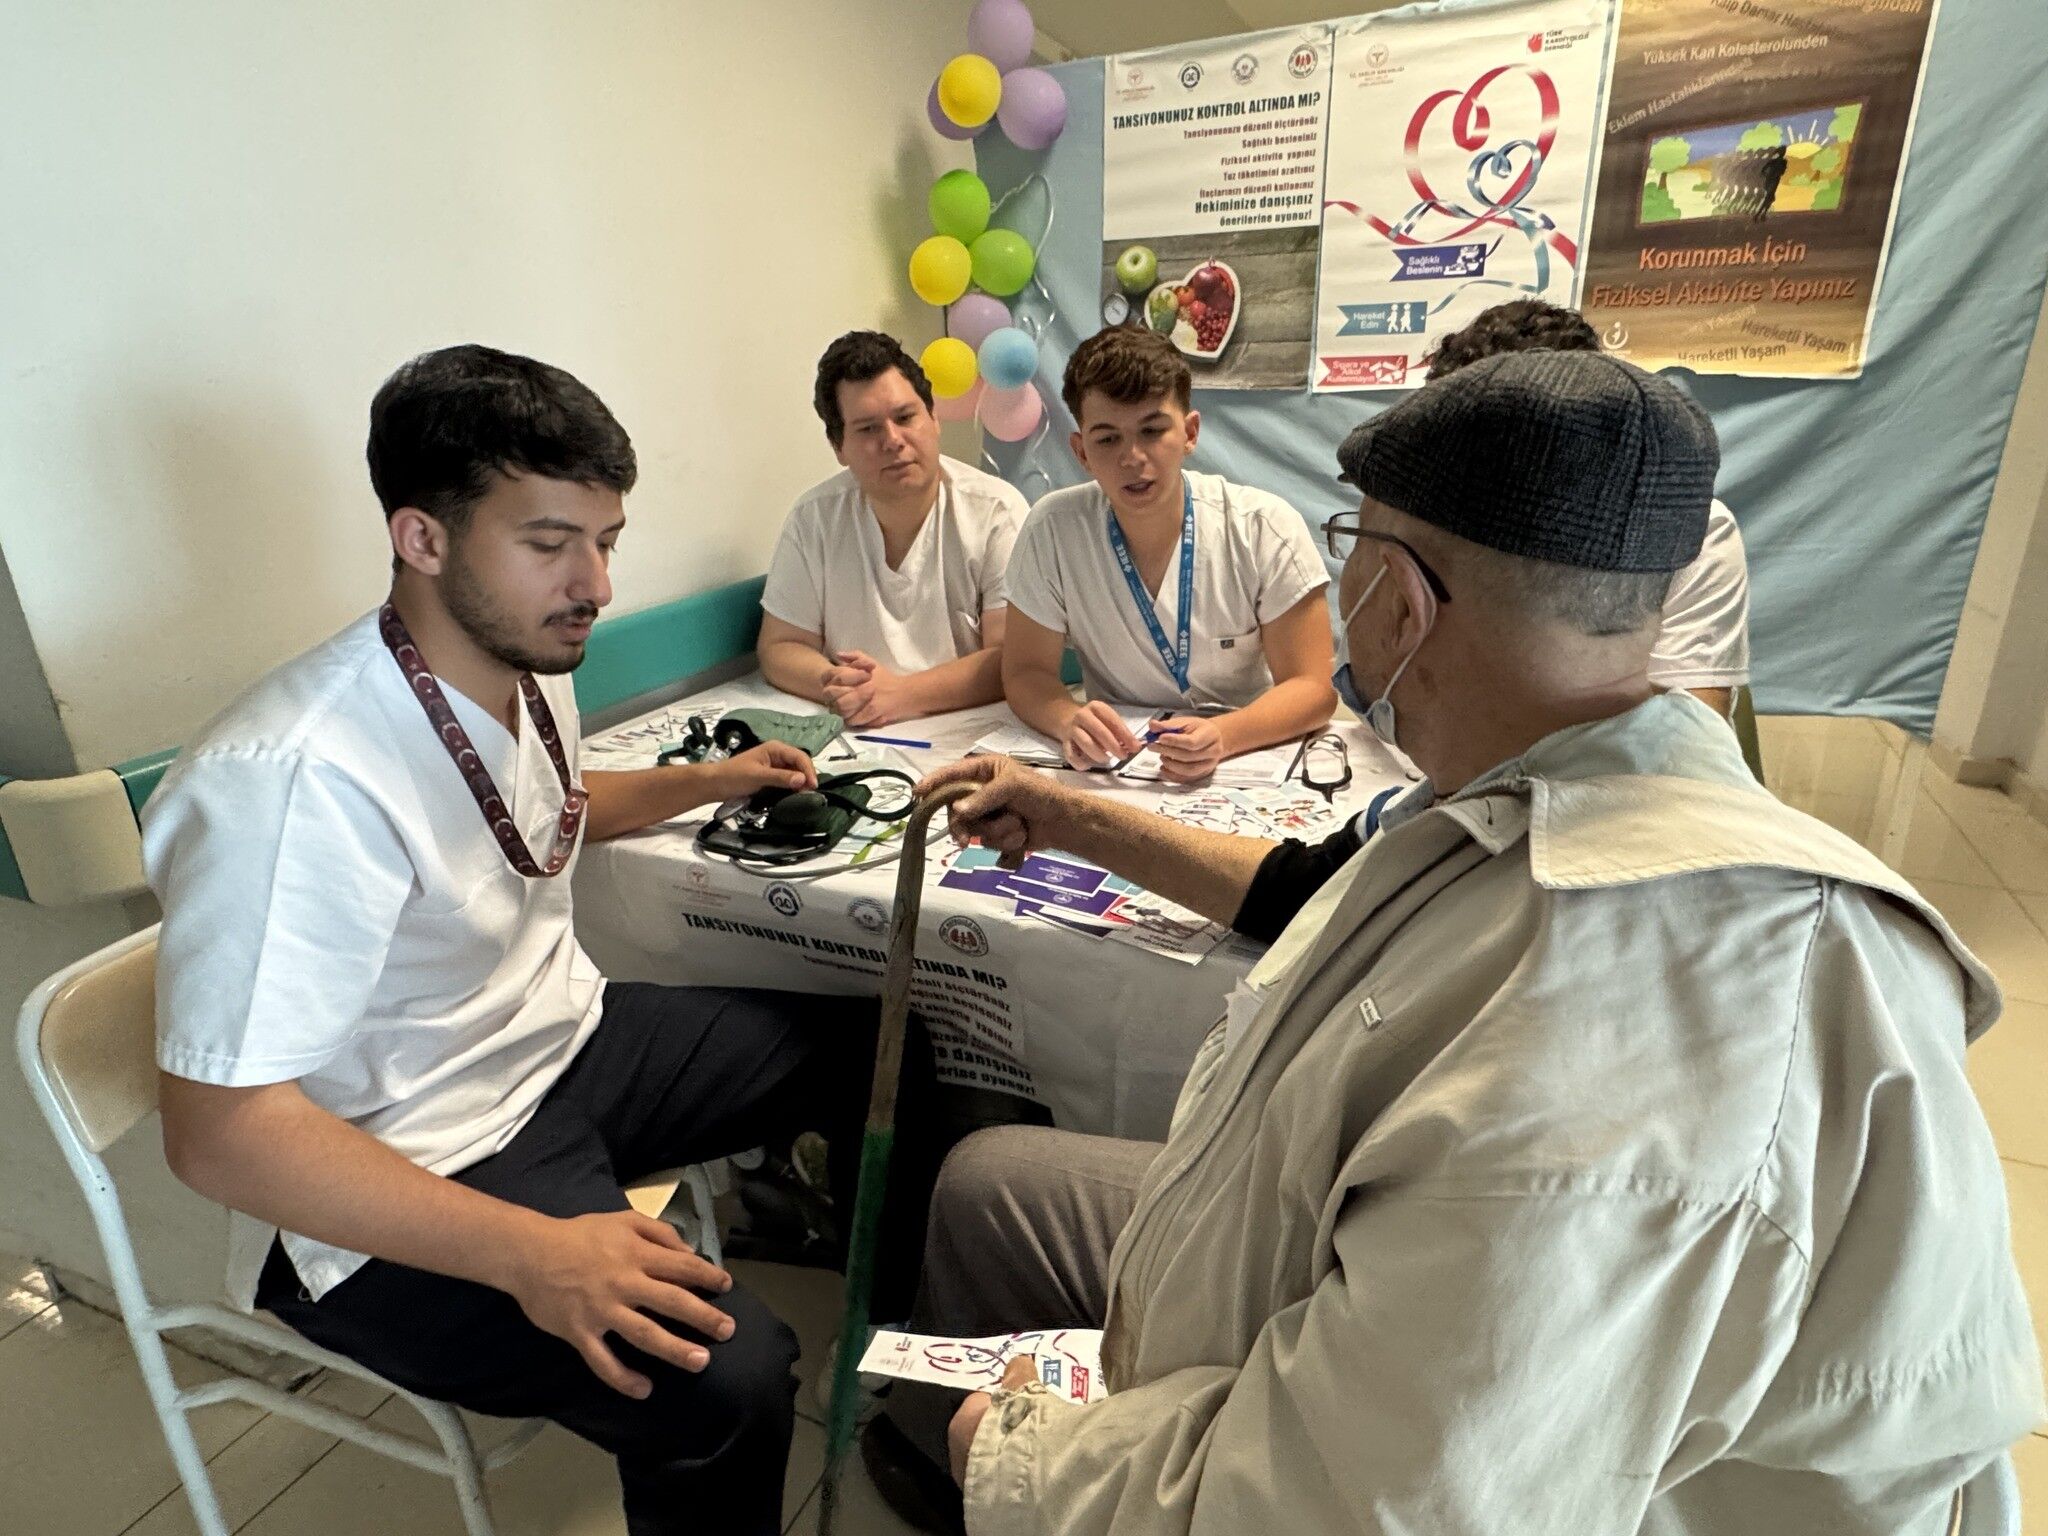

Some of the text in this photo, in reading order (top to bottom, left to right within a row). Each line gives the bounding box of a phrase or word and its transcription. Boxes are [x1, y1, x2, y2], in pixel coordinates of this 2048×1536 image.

[1690, 46, 1715, 60] Kan
[1113, 91, 1321, 130] TANSİYONUNUZ KONTROL ALTINDA MI?
[1242, 120, 1272, 133] düzenli
[1608, 108, 1647, 134] Eklem
[1242, 138, 1273, 149] Sağlıklı
[1221, 154, 1250, 166] Fiziksel
[1252, 151, 1283, 163] aktivite
[1223, 171, 1236, 181] Tuz
[1238, 167, 1279, 180] tüketimini
[1243, 182, 1272, 195] düzenli
[1195, 193, 1313, 214] Hekiminize danışınız
[1220, 208, 1312, 227] önerilerine uyunuz!
[1639, 235, 1807, 271] Korunmak İçin
[1592, 276, 1858, 308] Fiziksel Aktivite Yapınız
[1360, 320, 1380, 329] Edin
[1804, 331, 1848, 354] Yaşam
[1678, 344, 1787, 363] Hareketli Yaşam
[1184, 523, 1194, 545] IEEE
[1179, 638, 1189, 660] IEEE
[912, 958, 970, 979] TINDA
[972, 969, 1008, 991] MI?
